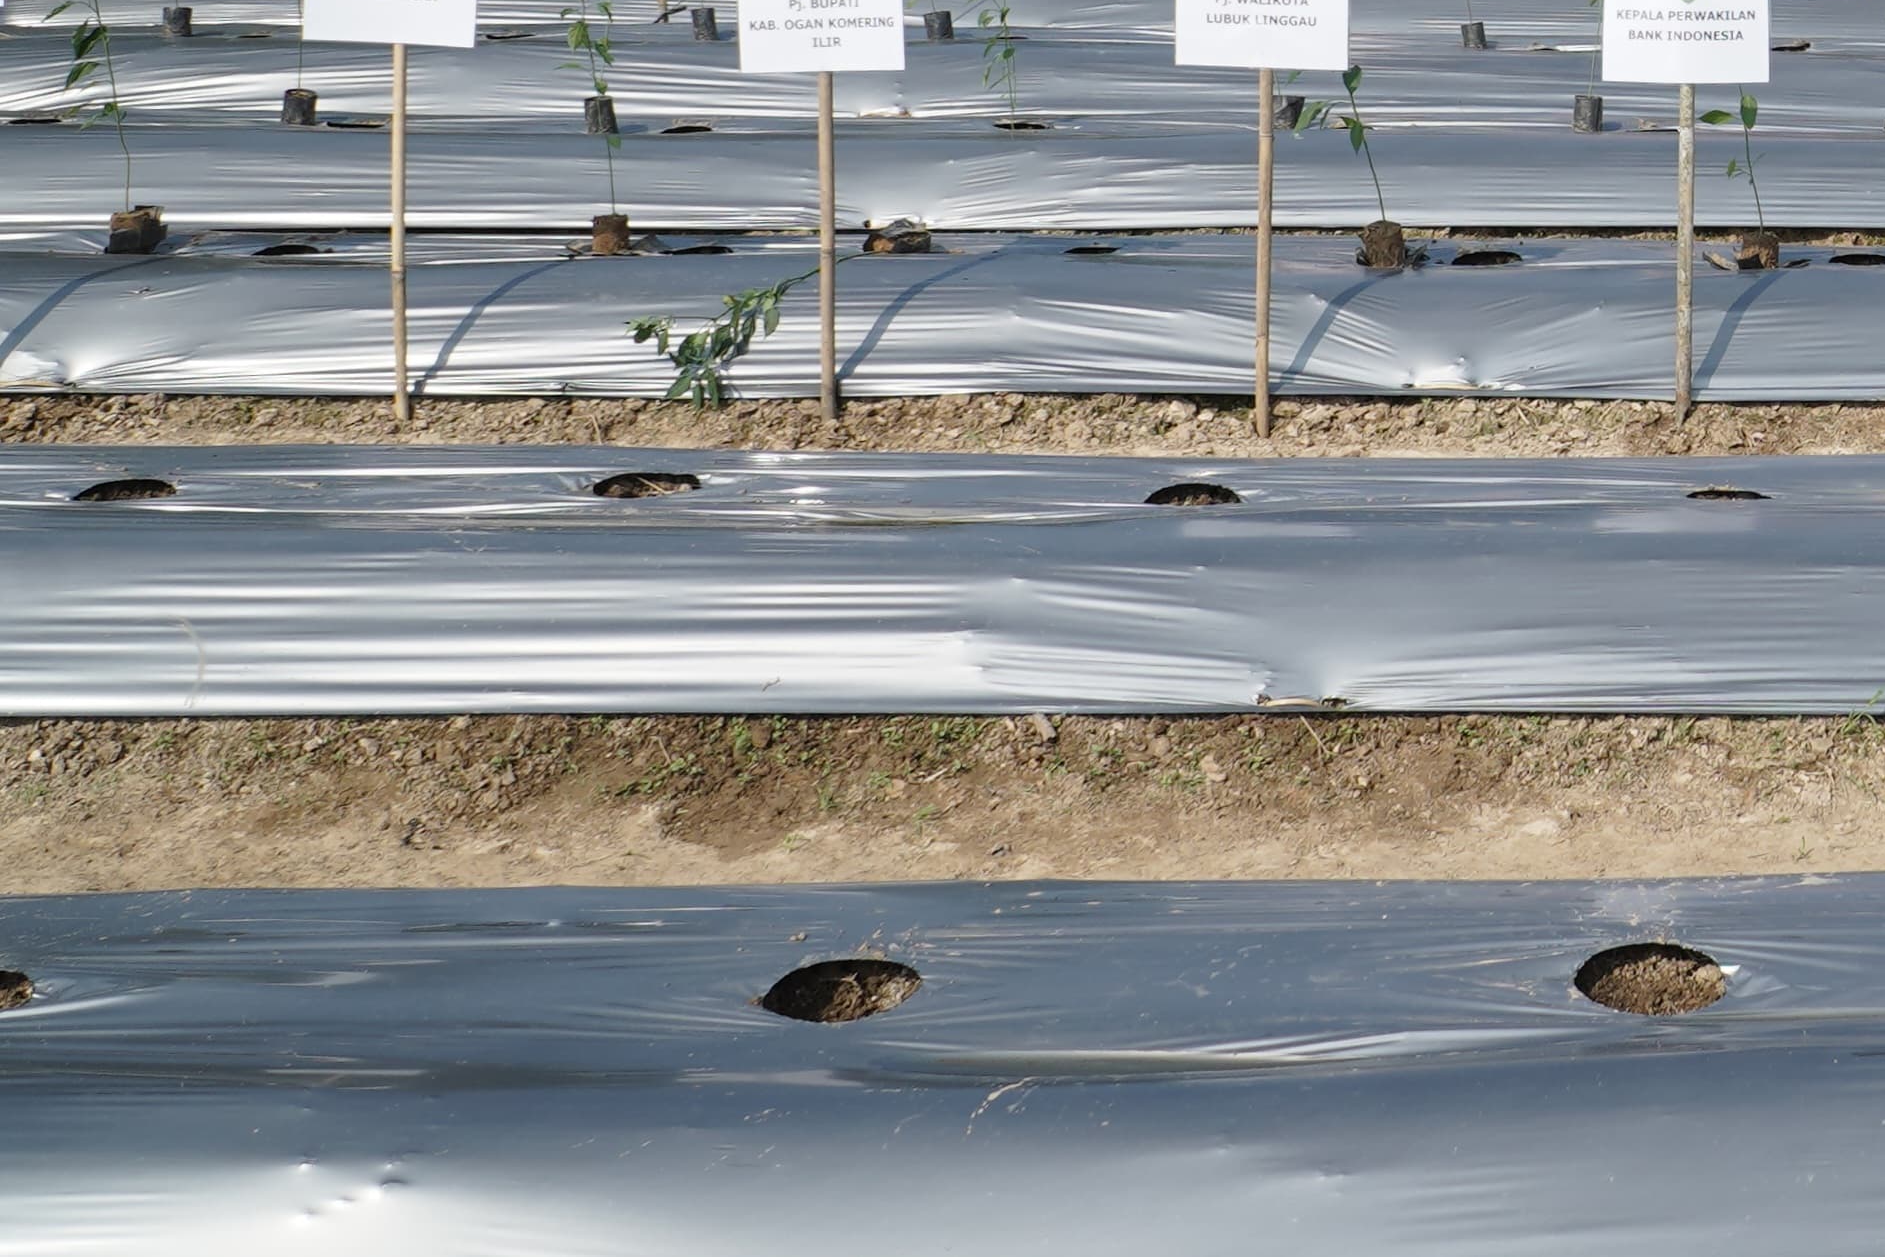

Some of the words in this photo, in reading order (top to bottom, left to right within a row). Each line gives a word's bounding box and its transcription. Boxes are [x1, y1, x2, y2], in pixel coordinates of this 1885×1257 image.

[1205, 13, 1251, 26] LUBUK
[1254, 14, 1318, 28] LINGGAU
[1616, 8, 1664, 22] KEPALA
[1668, 8, 1756, 22] PERWAKILAN
[748, 18, 779, 32] KAB.
[783, 17, 824, 31] OGAN
[828, 16, 895, 30] KOMERING
[811, 35, 842, 49] ILIR
[1627, 29, 1663, 42] BANK
[1666, 29, 1744, 42] INDONESIA
